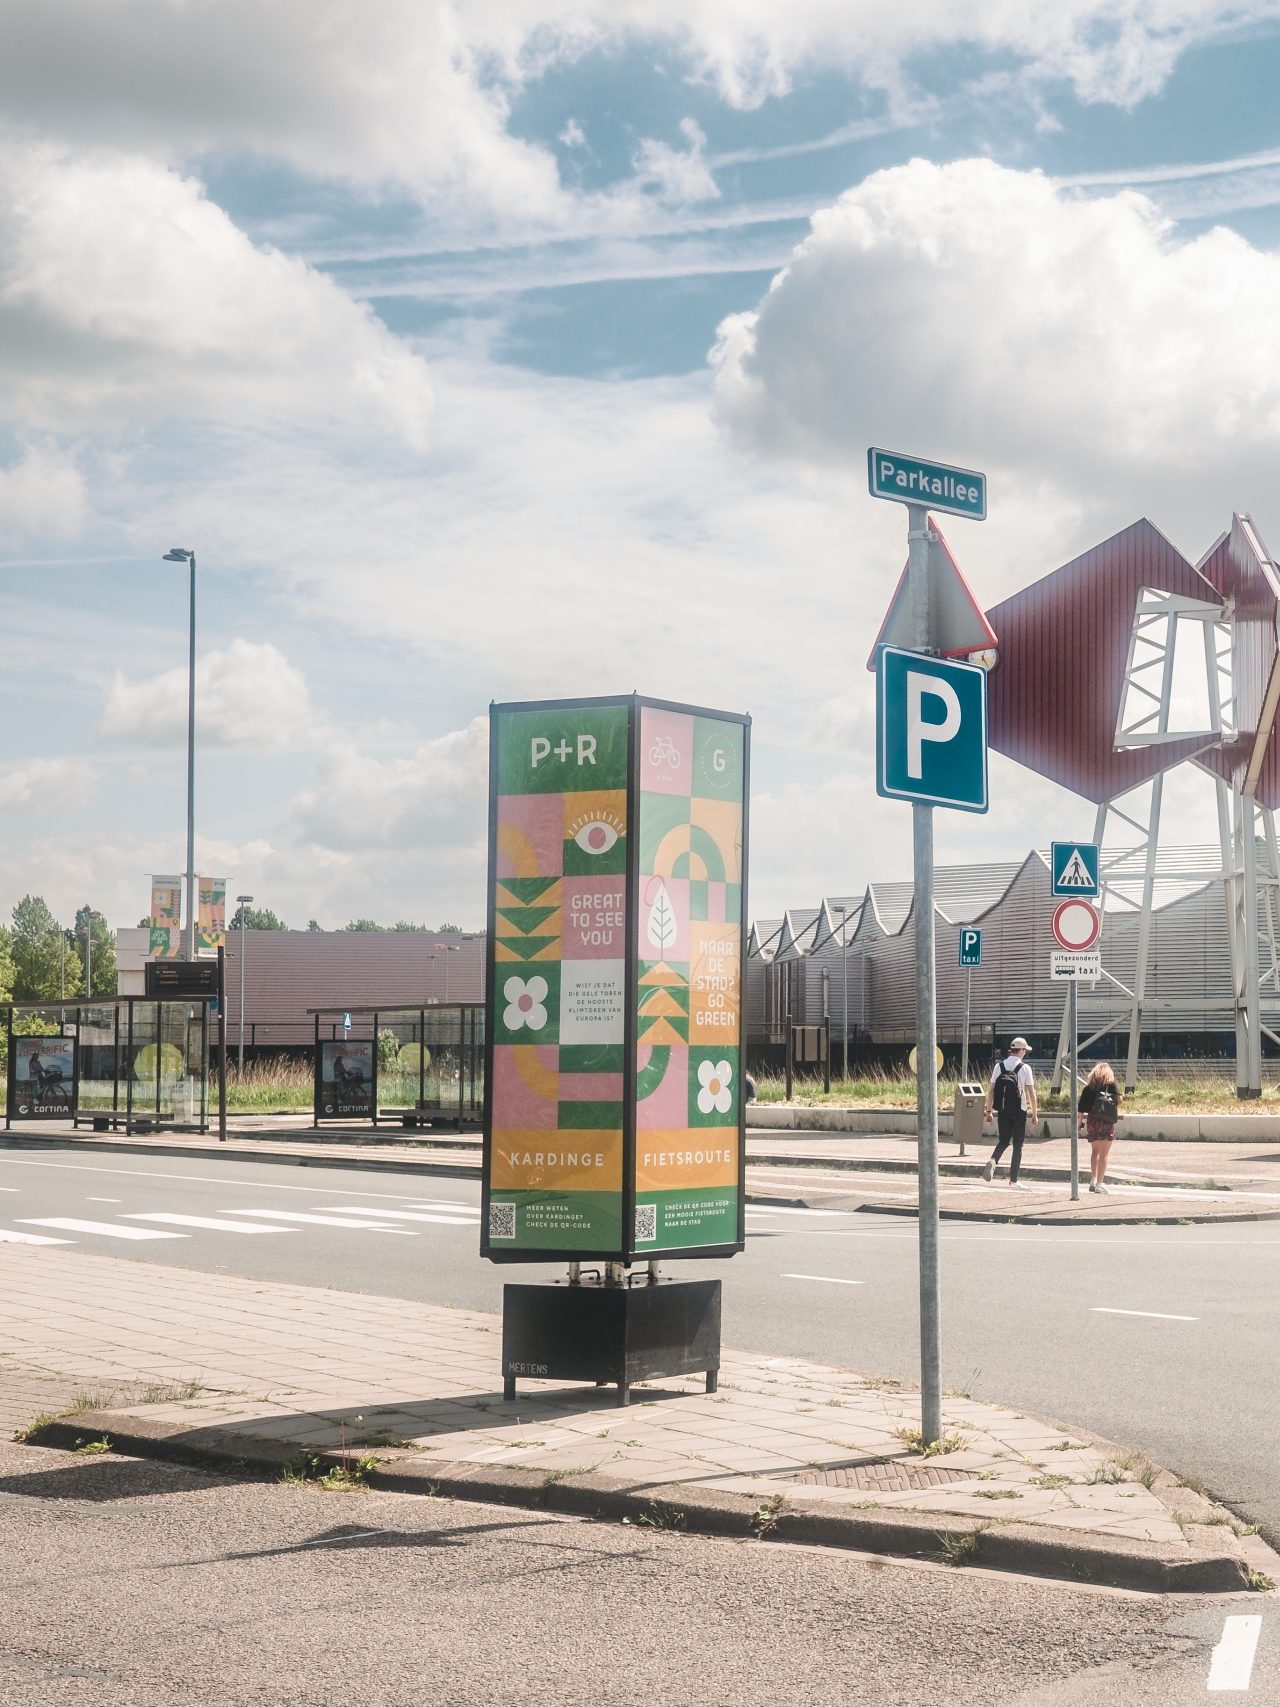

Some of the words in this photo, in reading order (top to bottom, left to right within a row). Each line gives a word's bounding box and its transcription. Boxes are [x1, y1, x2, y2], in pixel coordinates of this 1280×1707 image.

[880, 461, 979, 503] Parkallee
[907, 671, 962, 779] P
[531, 734, 597, 767] P+R
[571, 893, 623, 910] GREAT
[570, 913, 591, 928] TO
[595, 912, 624, 927] SEE
[580, 931, 613, 946] YOU
[965, 932, 978, 951] P
[700, 940, 733, 955] NAAR
[709, 958, 724, 973] DE
[963, 955, 979, 963] taxi
[697, 976, 735, 991] STAD?
[708, 993, 724, 1008] GO
[696, 1011, 735, 1026] GREEN
[511, 1153, 604, 1167] KARDINGE
[644, 1150, 731, 1167] FIETSROUTE
